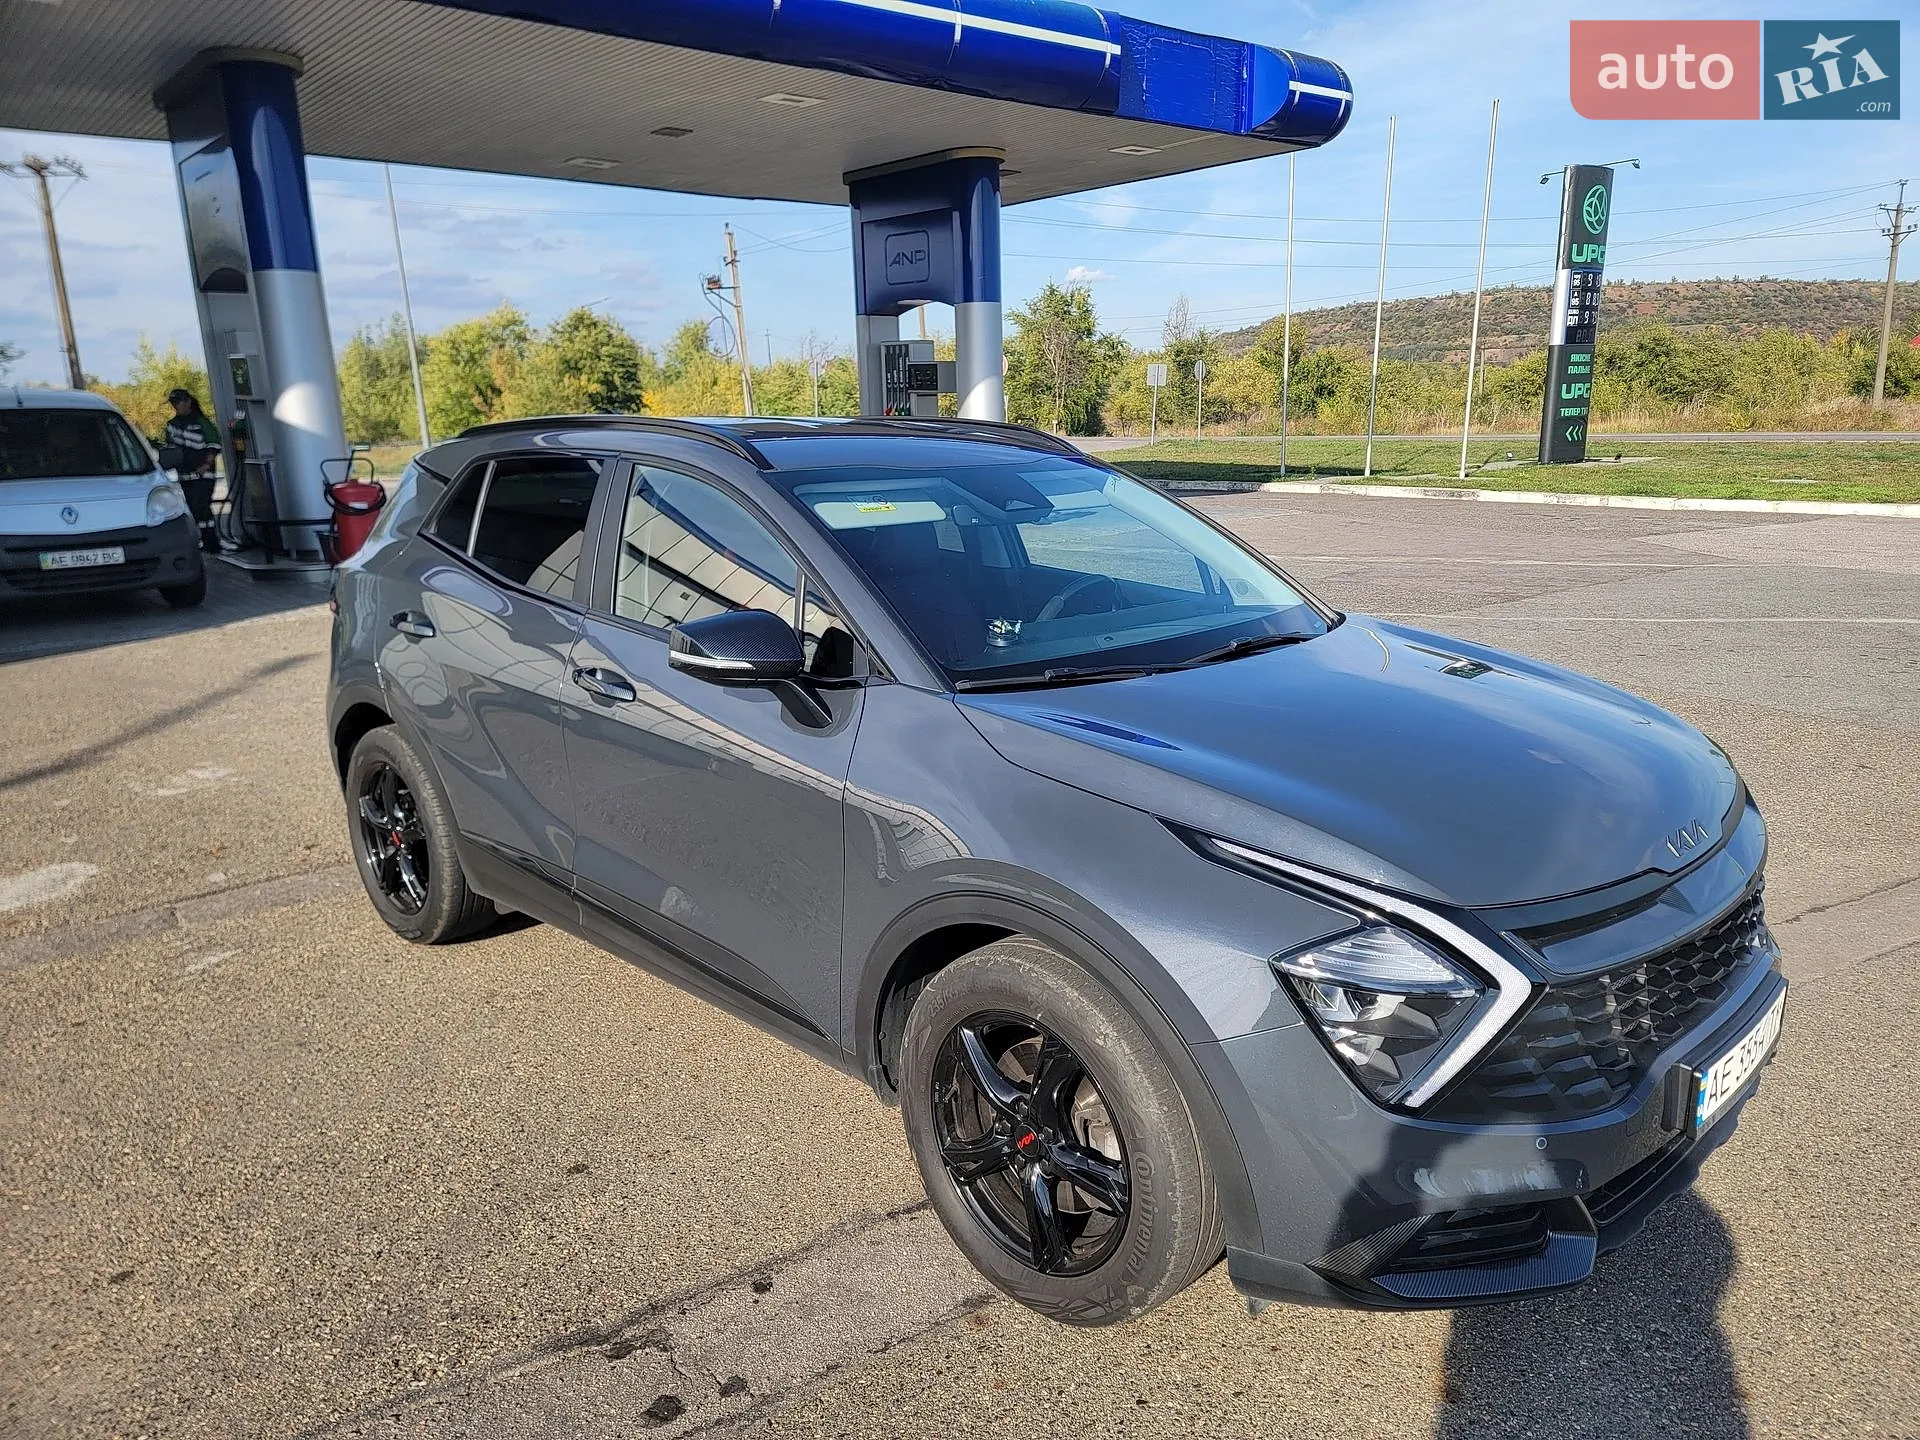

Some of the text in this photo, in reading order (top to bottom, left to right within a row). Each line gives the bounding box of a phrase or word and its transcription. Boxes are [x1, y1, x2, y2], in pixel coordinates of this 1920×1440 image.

[889, 249, 926, 267] ANP
[1561, 383, 1591, 399] UPG
[1707, 1055, 1734, 1111] AE
